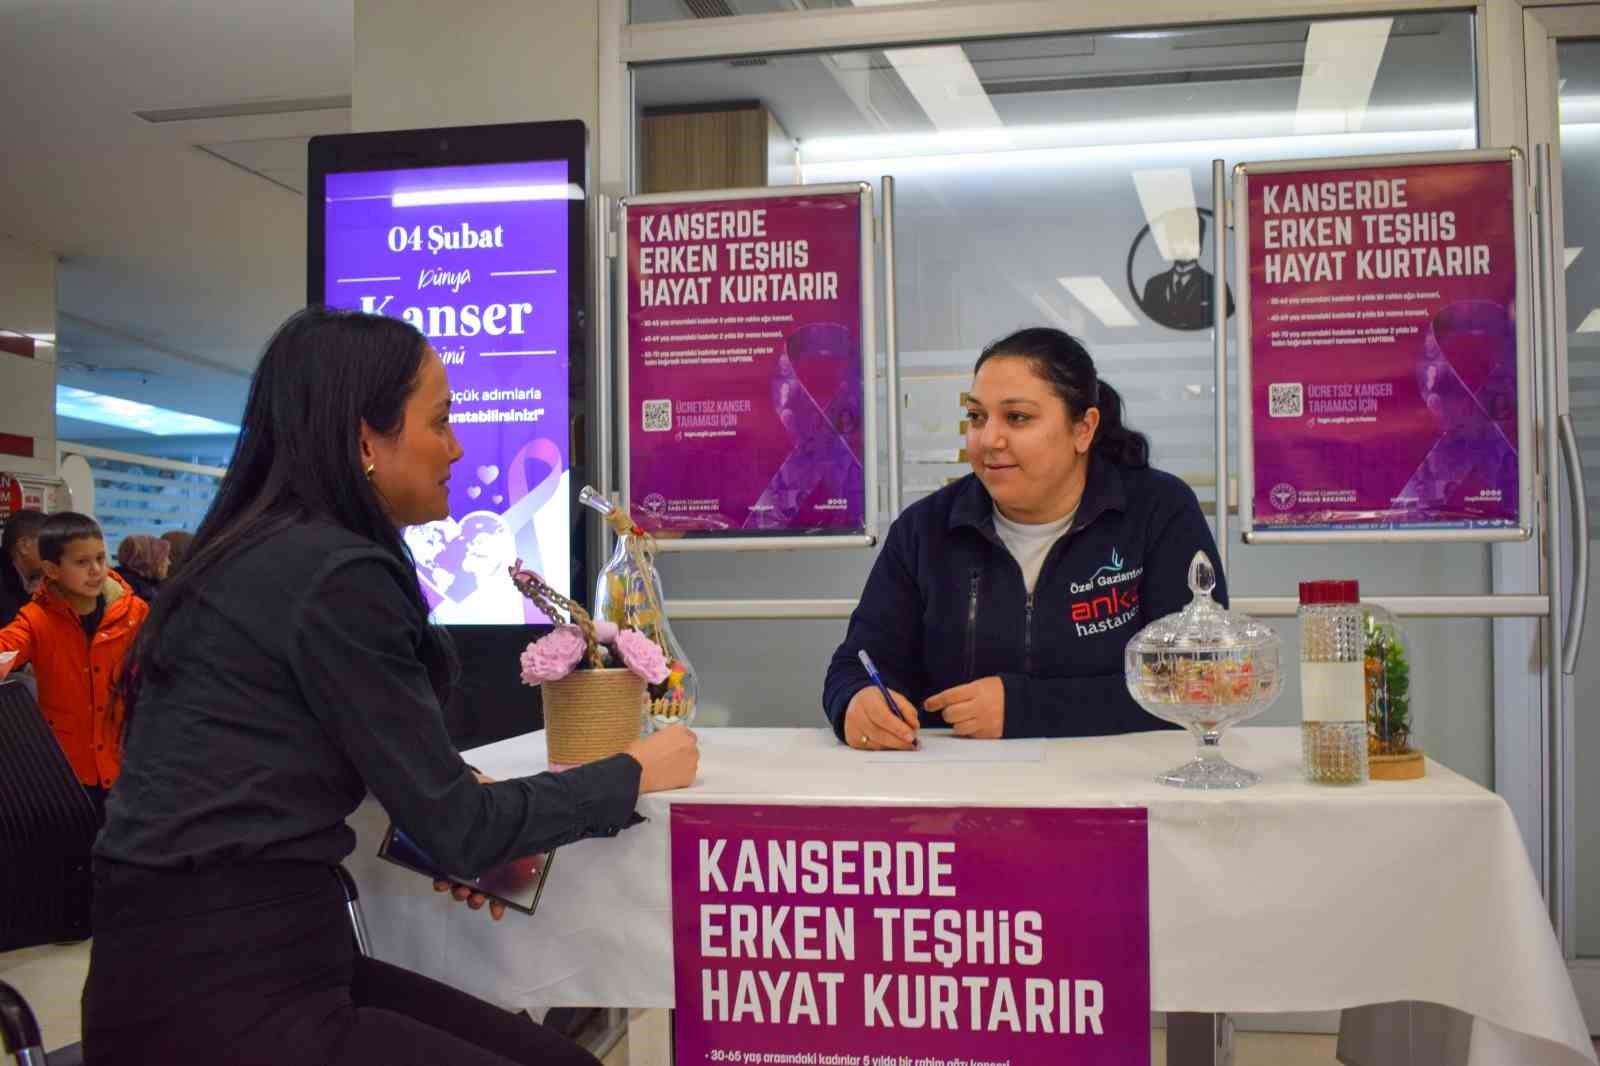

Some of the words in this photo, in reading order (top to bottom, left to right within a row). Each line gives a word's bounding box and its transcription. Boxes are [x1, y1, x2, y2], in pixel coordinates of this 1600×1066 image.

[1263, 179, 1407, 214] KANSERDE
[387, 225, 423, 252] 04
[428, 222, 504, 255] Şubat
[640, 209, 767, 242] KANSERDE
[1264, 216, 1352, 249] ERKEN
[640, 244, 717, 274] ERKEN
[1265, 251, 1346, 284] HAYAT
[1356, 245, 1490, 280] KURTARIR
[417, 266, 471, 293] Dünya
[640, 277, 711, 307] HAYAT
[720, 272, 838, 303] KURTARIR
[482, 387, 542, 401] adımlarla
[1354, 382, 1393, 397] KANSER
[1070, 579, 1095, 594] Özel
[699, 838, 956, 897] KANSERDE
[700, 904, 855, 961] ERKEN
[702, 969, 844, 1026] HAYAT
[864, 973, 1104, 1035] KURTARIR
[743, 1052, 761, 1065] yaş
[763, 1052, 817, 1065] arasındaki
[818, 1053, 860, 1066] kadınlar
[863, 1055, 870, 1066] 5
[872, 1055, 896, 1066] yılda
